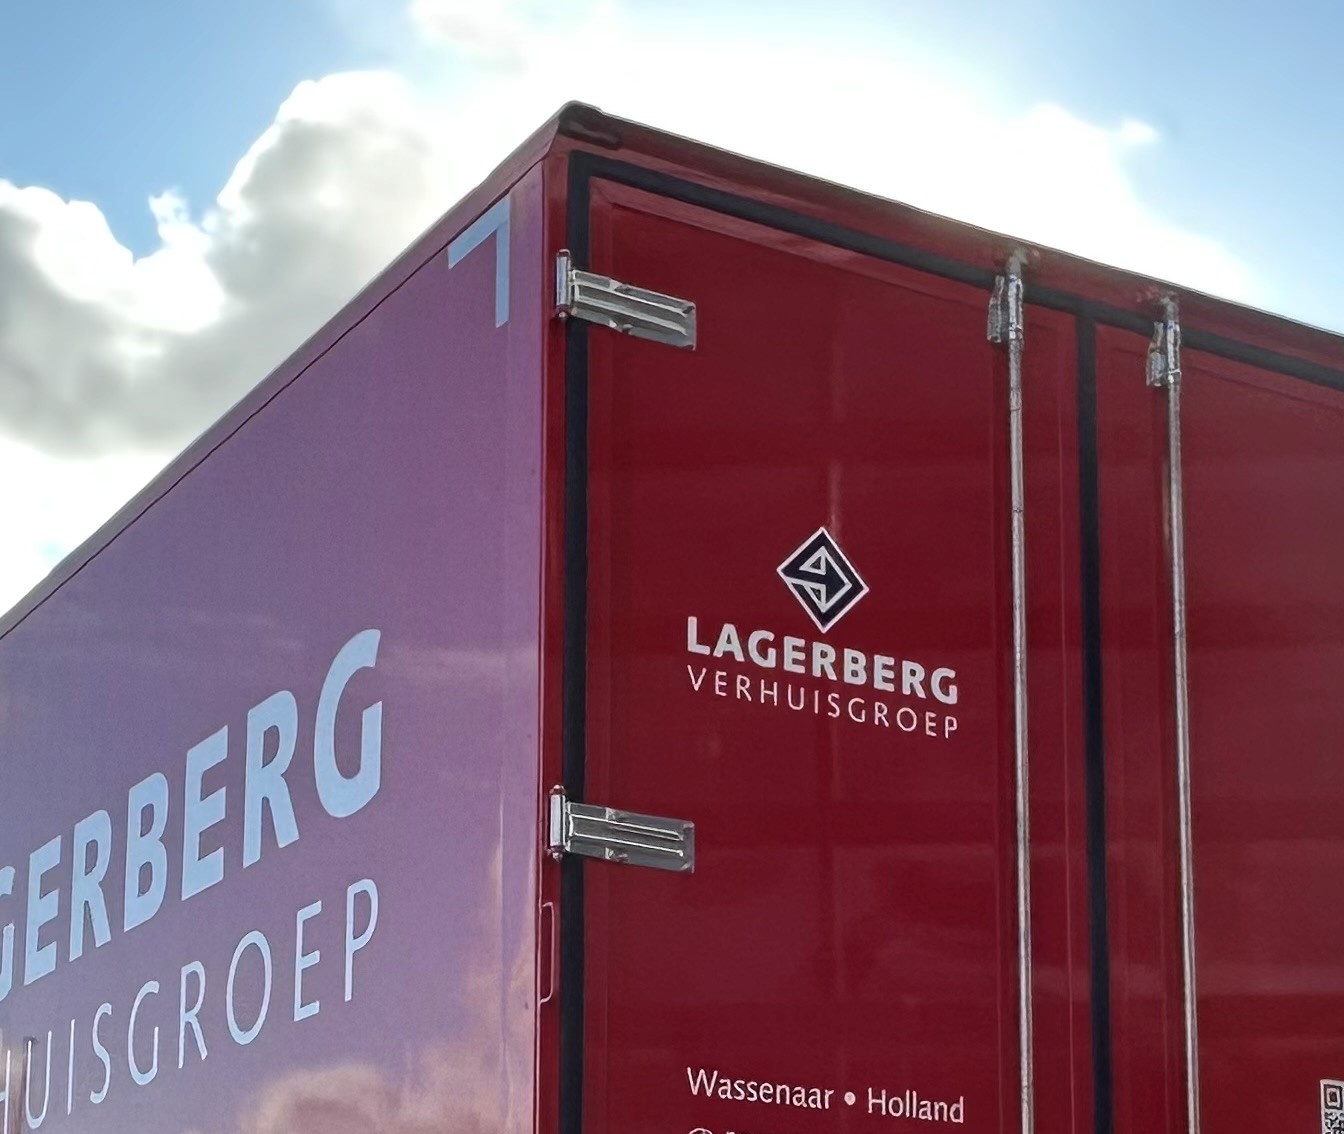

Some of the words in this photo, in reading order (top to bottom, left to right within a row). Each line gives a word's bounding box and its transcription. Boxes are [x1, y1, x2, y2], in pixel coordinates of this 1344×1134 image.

[686, 615, 958, 706] LAGERBERG
[686, 664, 958, 739] VERHUISGROEP
[686, 1066, 835, 1110] Wassenaar
[867, 1086, 965, 1124] Holland
